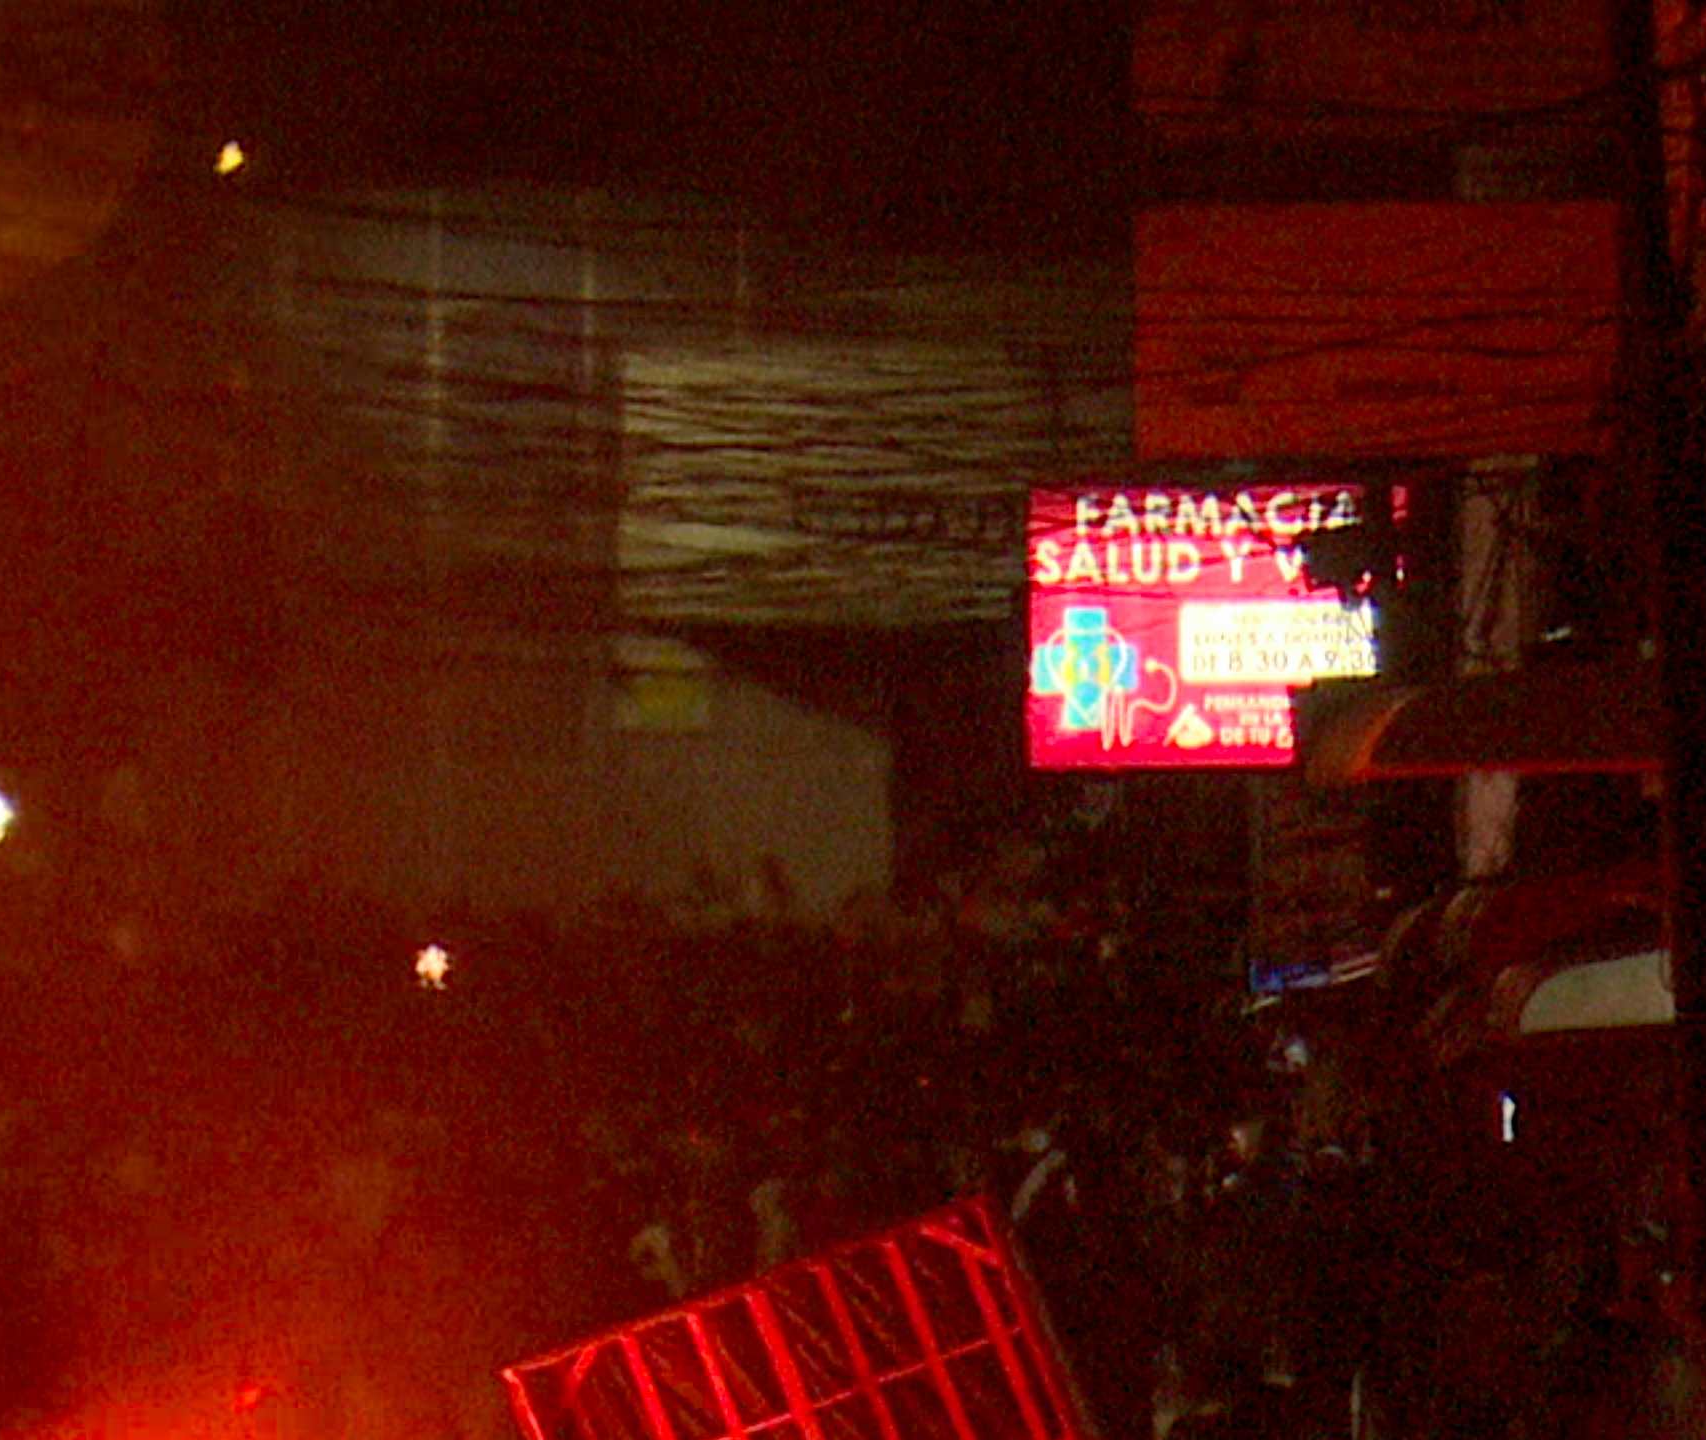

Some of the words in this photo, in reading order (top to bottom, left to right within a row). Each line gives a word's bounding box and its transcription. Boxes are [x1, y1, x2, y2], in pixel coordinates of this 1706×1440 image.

[1076, 491, 1362, 536] FARMACIA
[1034, 540, 1201, 584] SALUD
[1220, 540, 1252, 583] Y
